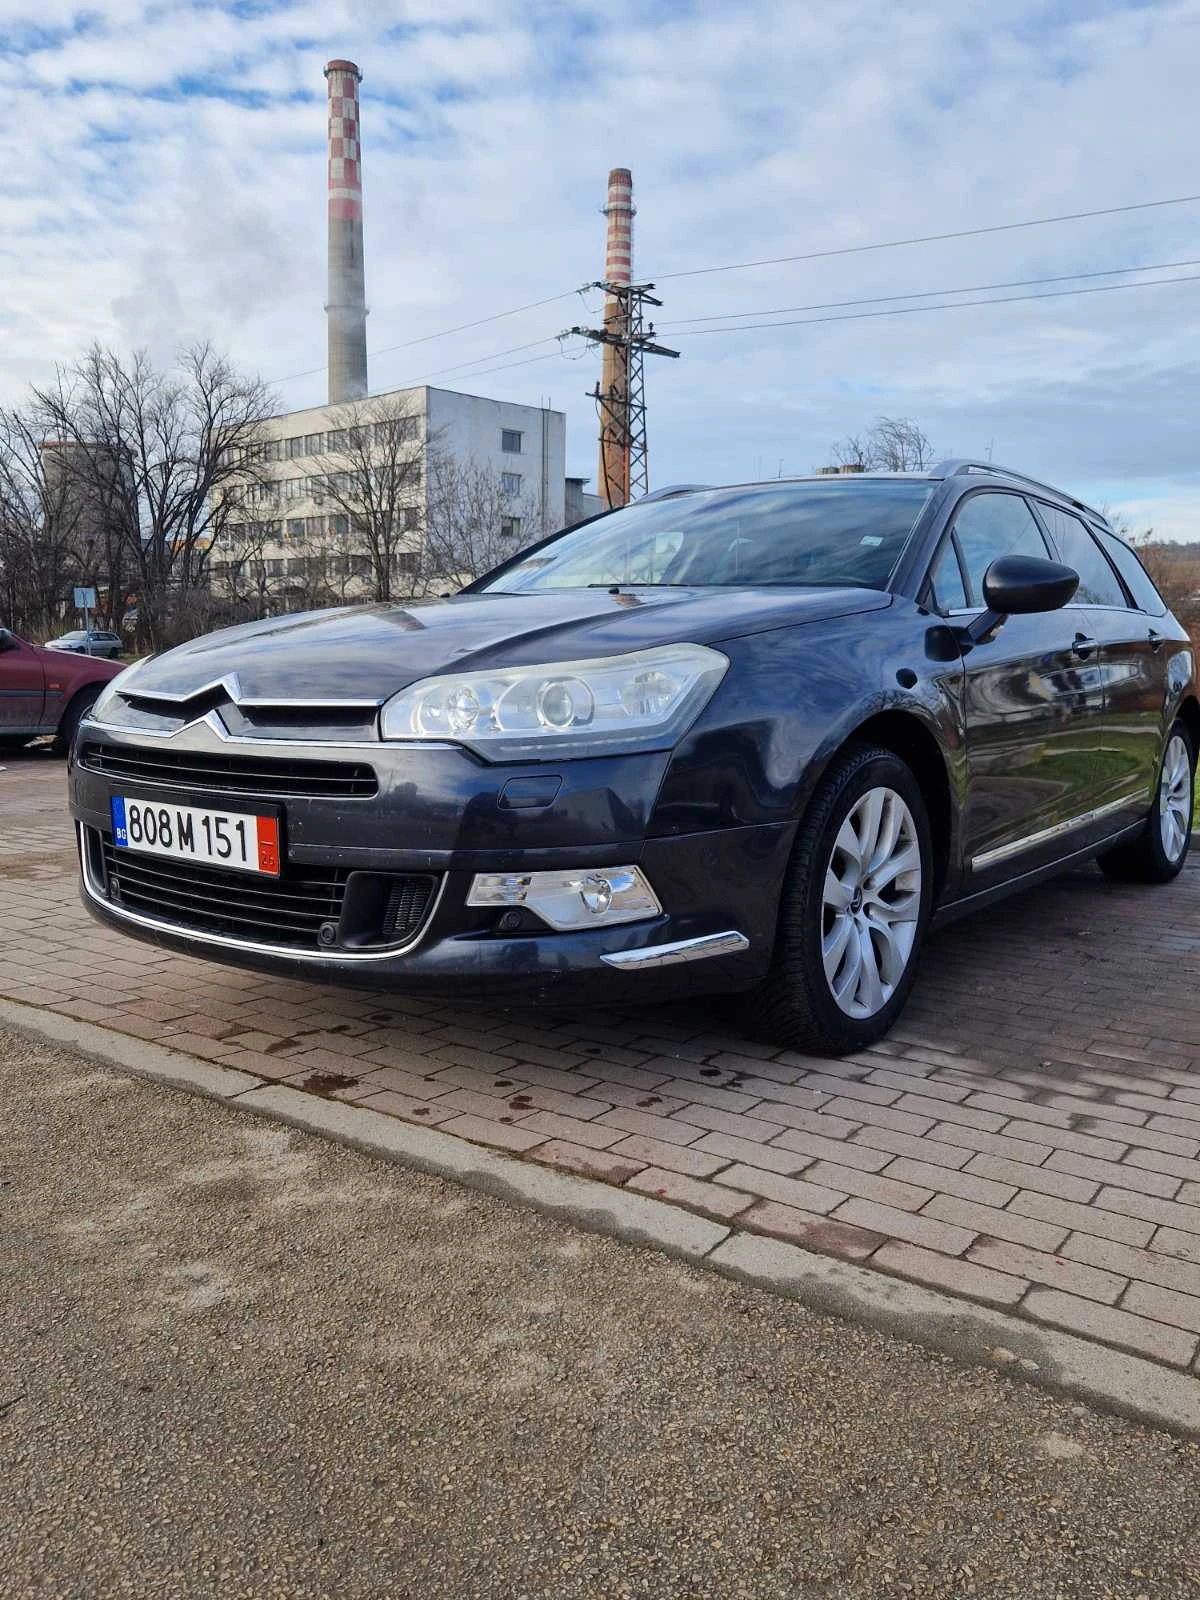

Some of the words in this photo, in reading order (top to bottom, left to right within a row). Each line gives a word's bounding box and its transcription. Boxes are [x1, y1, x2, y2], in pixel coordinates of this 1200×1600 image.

[116, 827, 127, 840] BG
[129, 804, 173, 848] 808
[201, 815, 247, 862] 151
